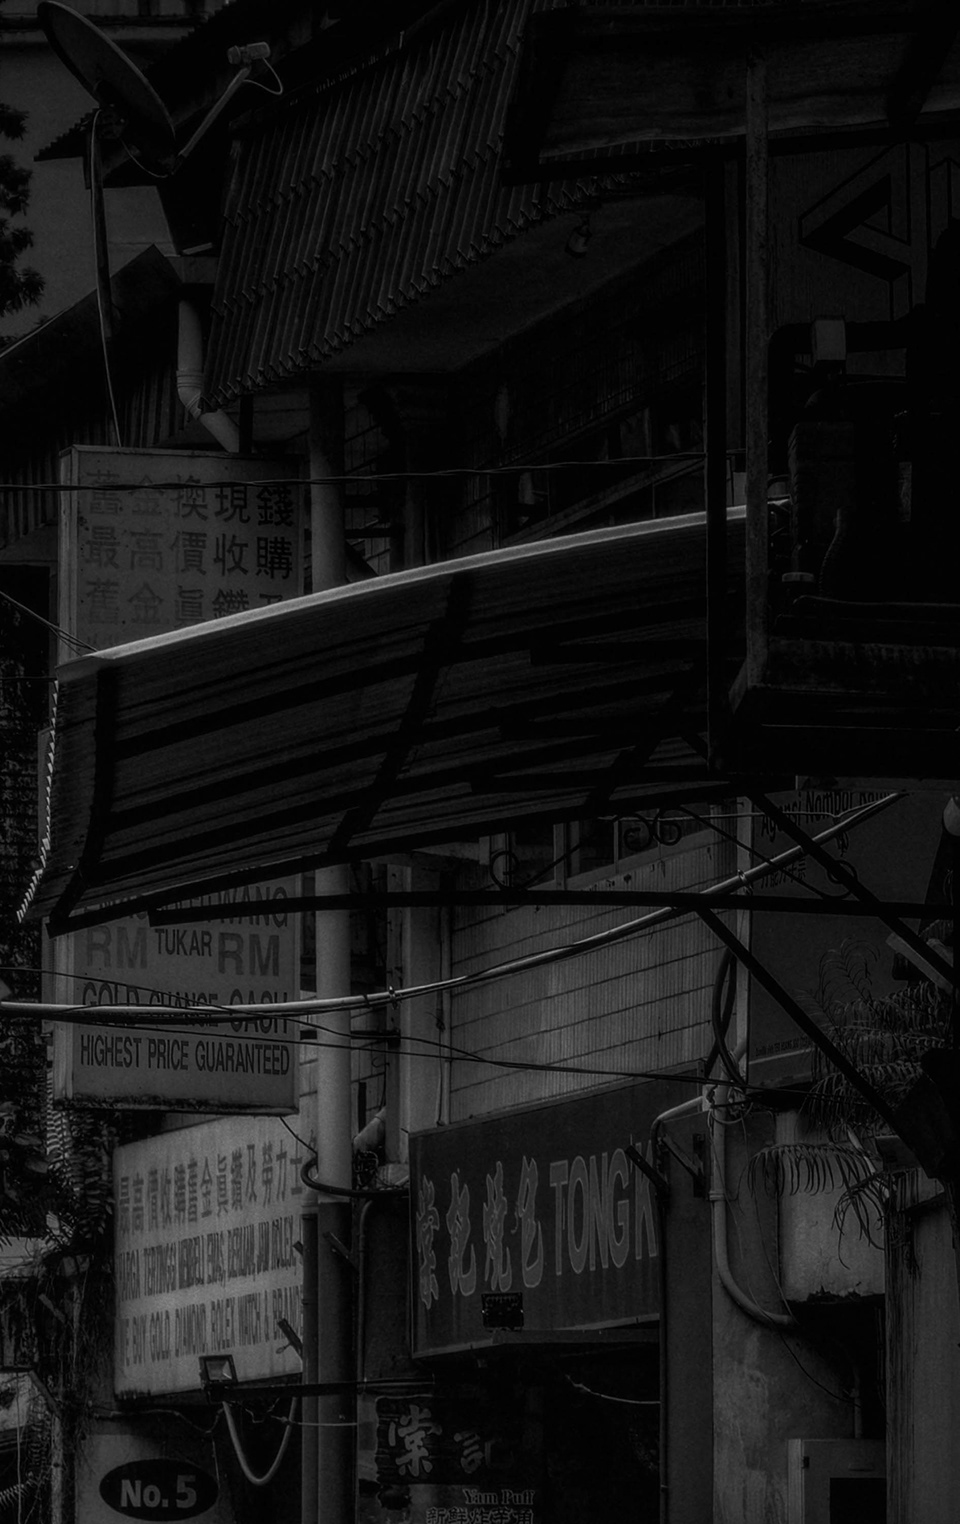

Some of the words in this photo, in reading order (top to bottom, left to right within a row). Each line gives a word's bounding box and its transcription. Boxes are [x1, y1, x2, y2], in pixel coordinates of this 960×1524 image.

[83, 525, 294, 580] 最高價收購
[86, 925, 148, 969] RM
[154, 928, 213, 958] TUKAR
[217, 931, 280, 977] RM
[80, 1034, 142, 1069] HIGHEST
[147, 1036, 190, 1071] PRICE
[195, 1040, 290, 1076] GUARANTEED
[549, 1147, 631, 1276] TONG
[462, 1488, 499, 1506] Yam
[500, 1488, 536, 1506] Puff
